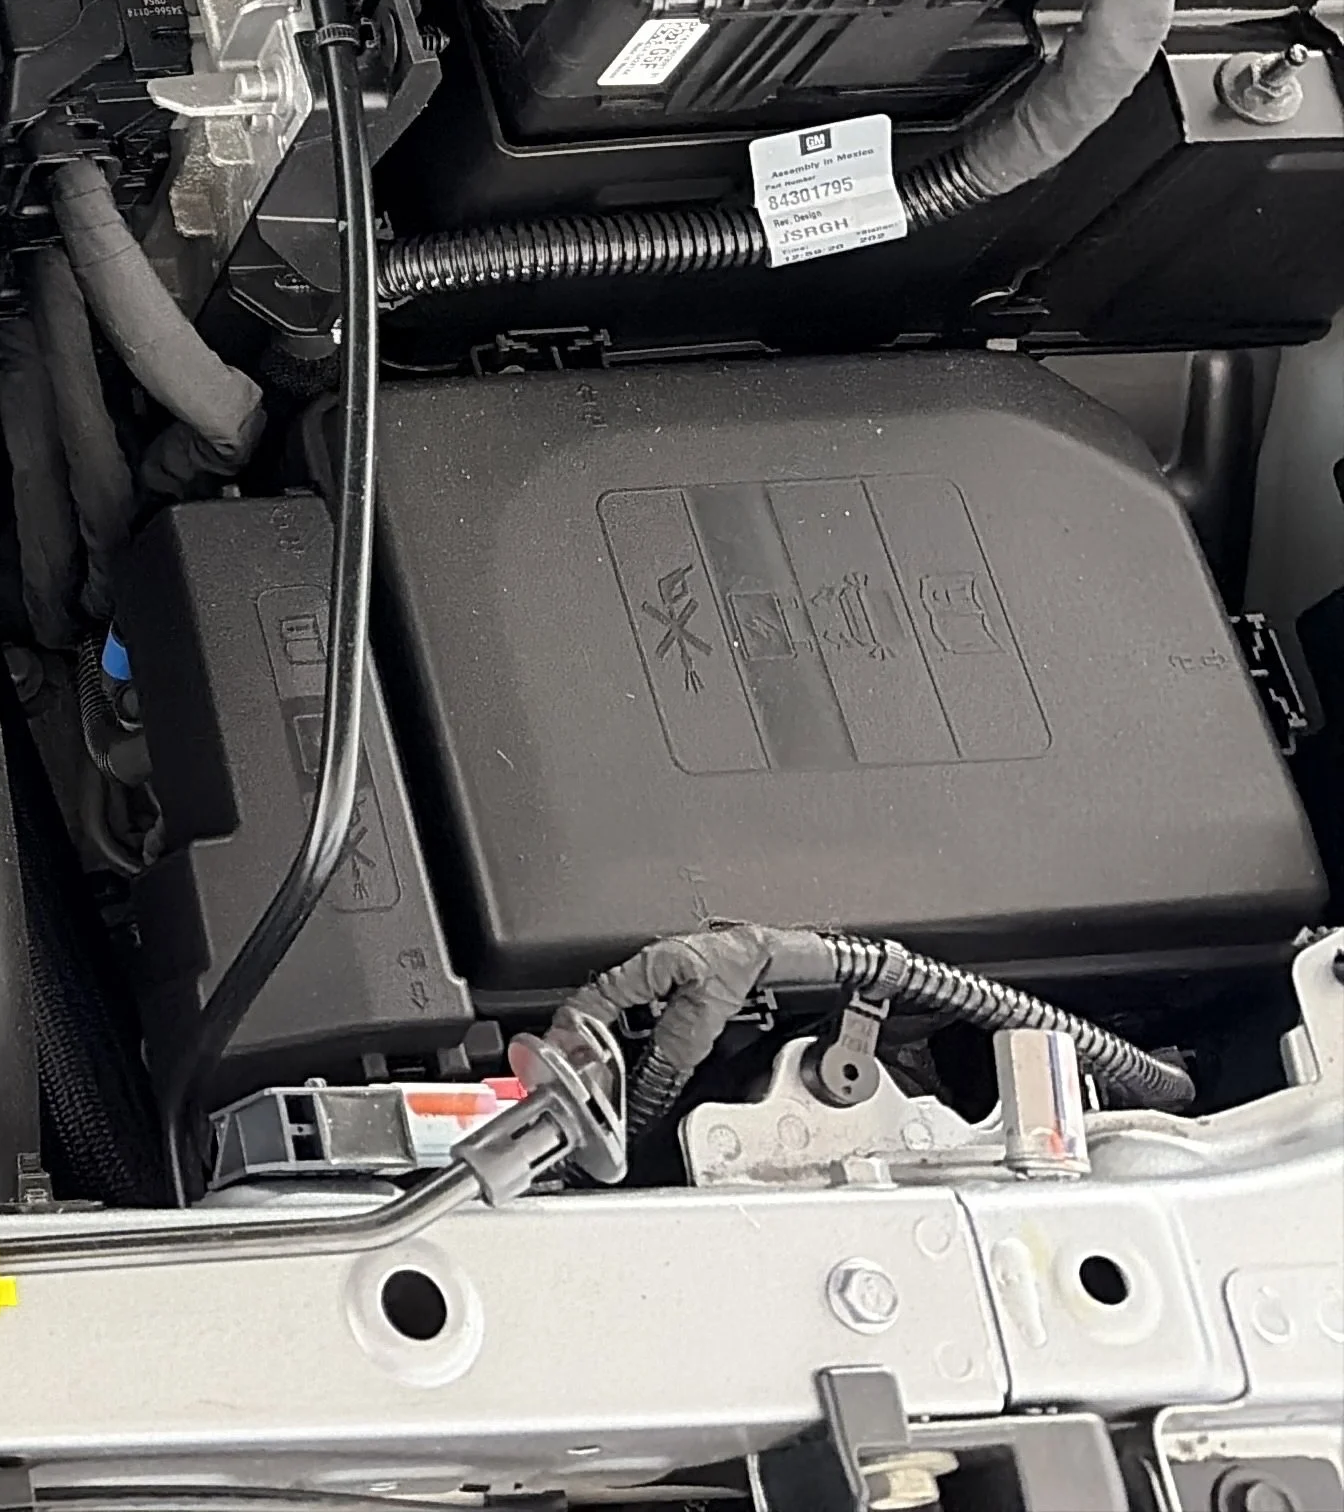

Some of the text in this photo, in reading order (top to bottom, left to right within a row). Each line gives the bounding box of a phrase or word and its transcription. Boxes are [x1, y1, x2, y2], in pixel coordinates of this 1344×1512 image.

[771, 148, 874, 179] Assembly in Mexico
[768, 177, 853, 211] 84301795
[779, 217, 849, 244] JSRGH
[794, 210, 822, 223] Design
